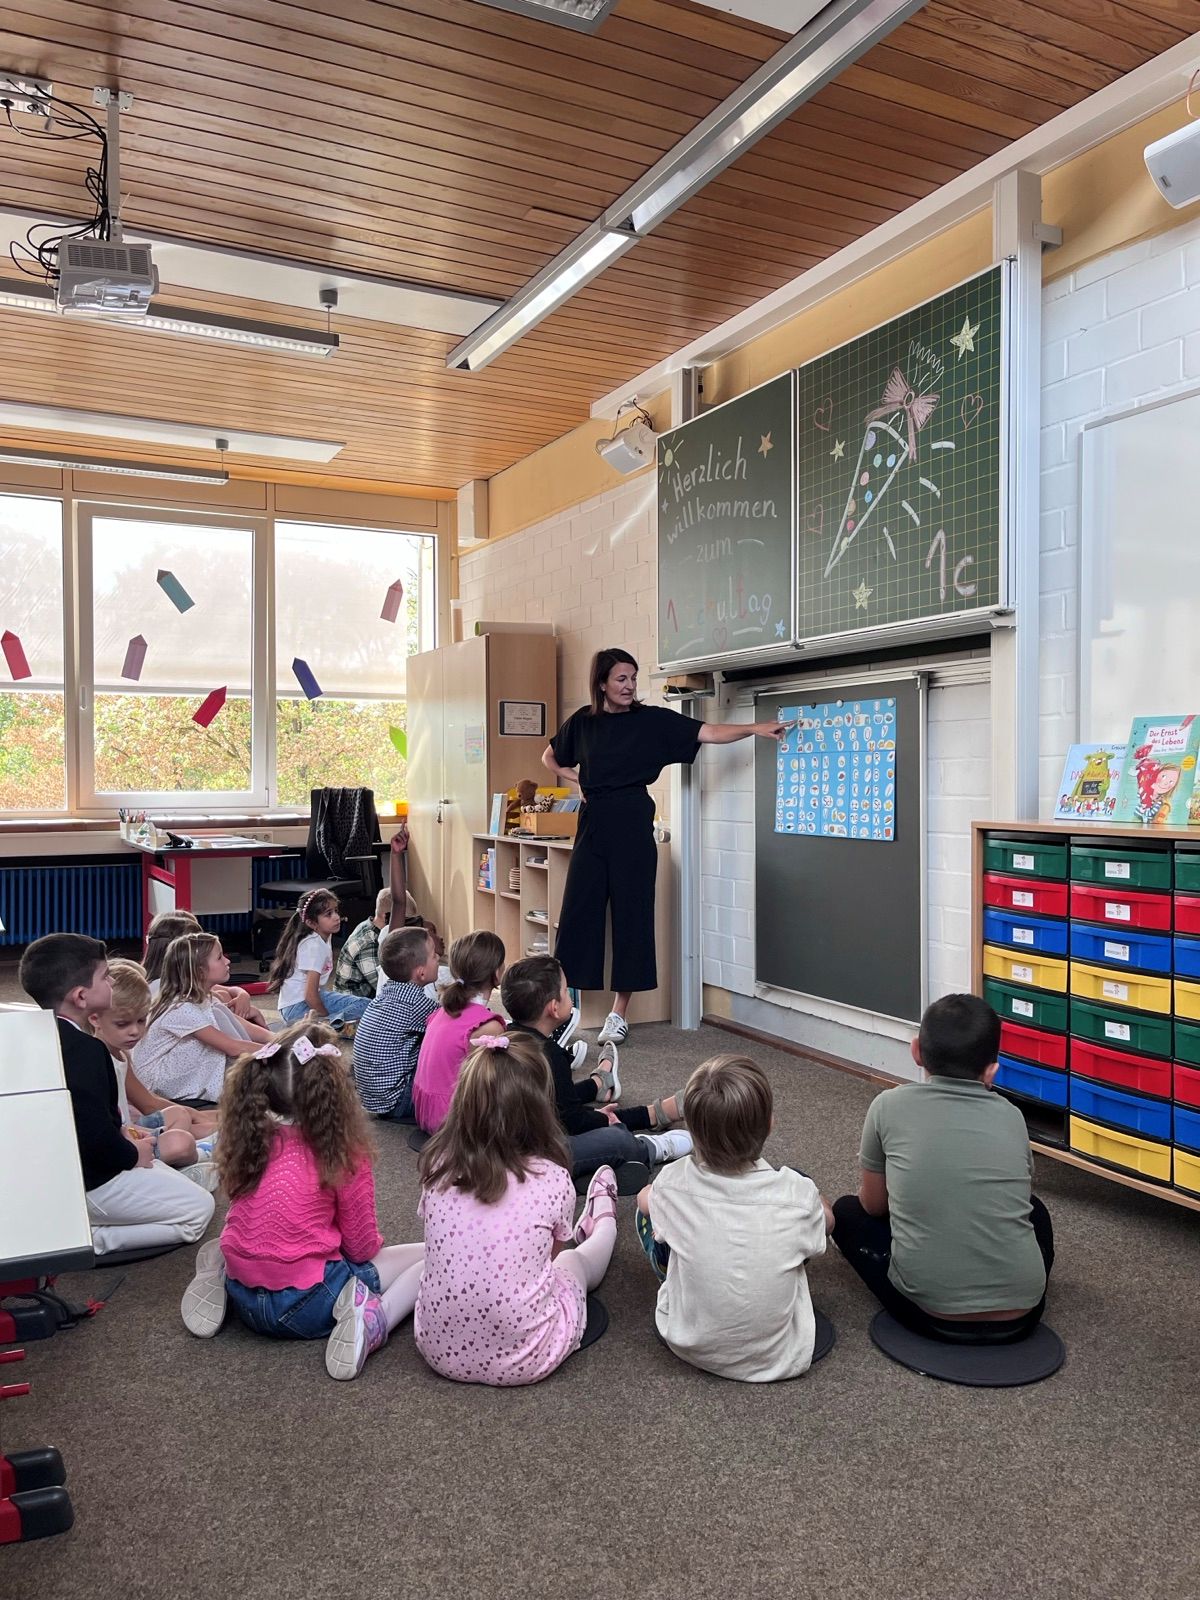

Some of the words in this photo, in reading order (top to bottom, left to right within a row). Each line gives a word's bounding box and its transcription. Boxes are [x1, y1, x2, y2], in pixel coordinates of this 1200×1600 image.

[672, 436, 748, 503] Herzlich
[666, 497, 778, 545] willkommen
[695, 536, 735, 563] zum
[924, 527, 978, 602] 1c
[1160, 728, 1178, 737] Ernst
[1161, 737, 1184, 746] Lebens
